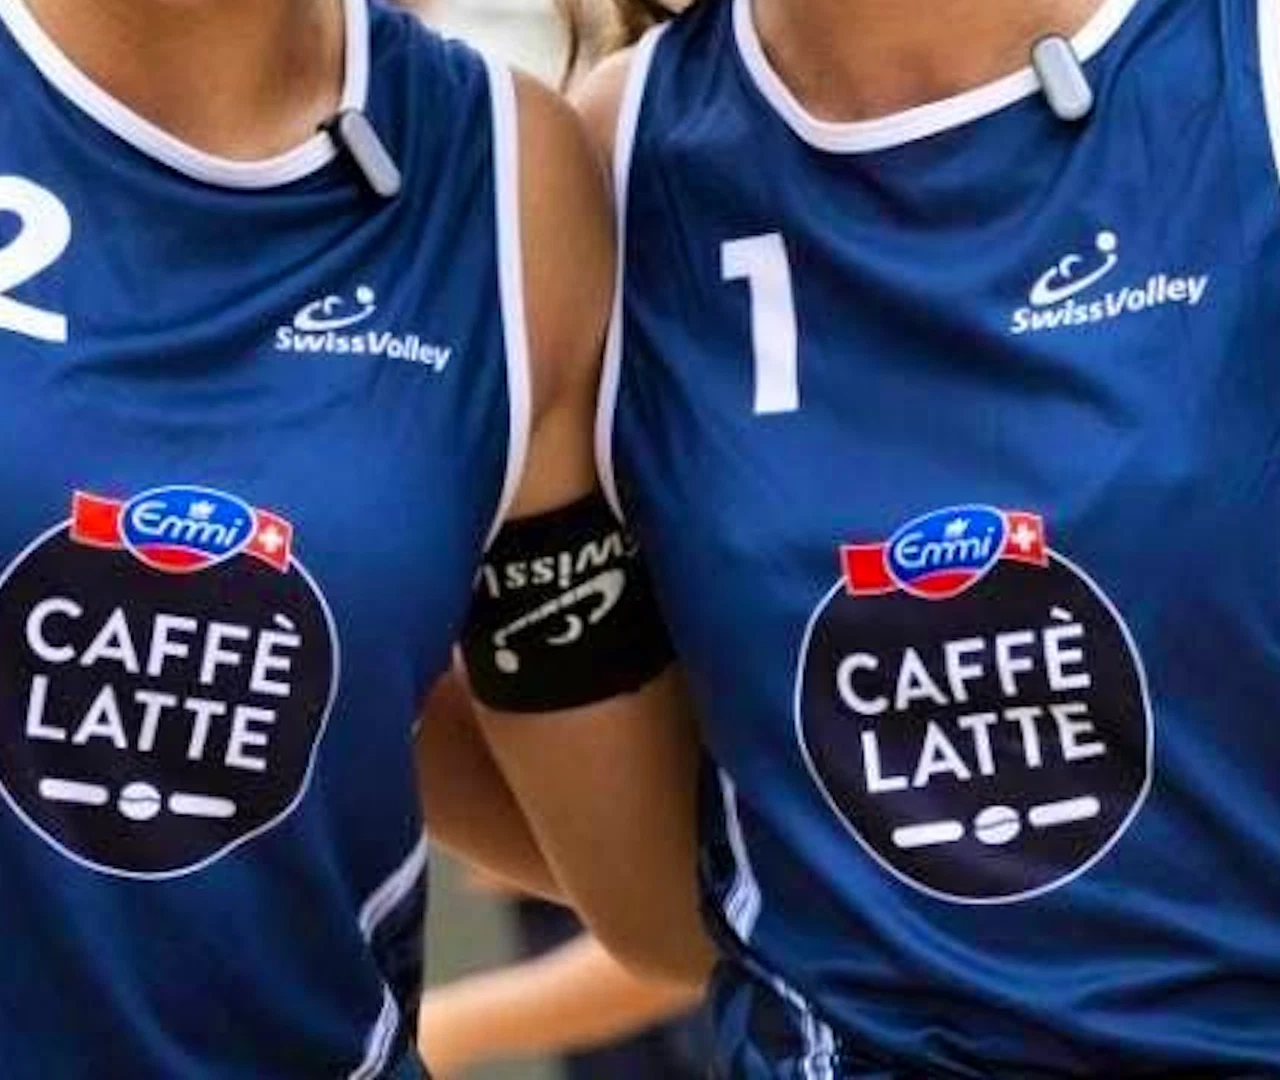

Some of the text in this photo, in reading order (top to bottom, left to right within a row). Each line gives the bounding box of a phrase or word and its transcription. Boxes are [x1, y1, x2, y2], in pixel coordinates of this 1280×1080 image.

[275, 325, 453, 372] SwissVolley
[721, 232, 800, 415] 1
[1010, 273, 1210, 335] SwissVolley
[130, 500, 244, 547] Emmi
[894, 524, 996, 572] Emmi
[25, 597, 301, 697] CAFFÈ
[836, 608, 1093, 714] CAFFÈ
[25, 676, 277, 772] LATTE
[862, 702, 1108, 795] LATTE
